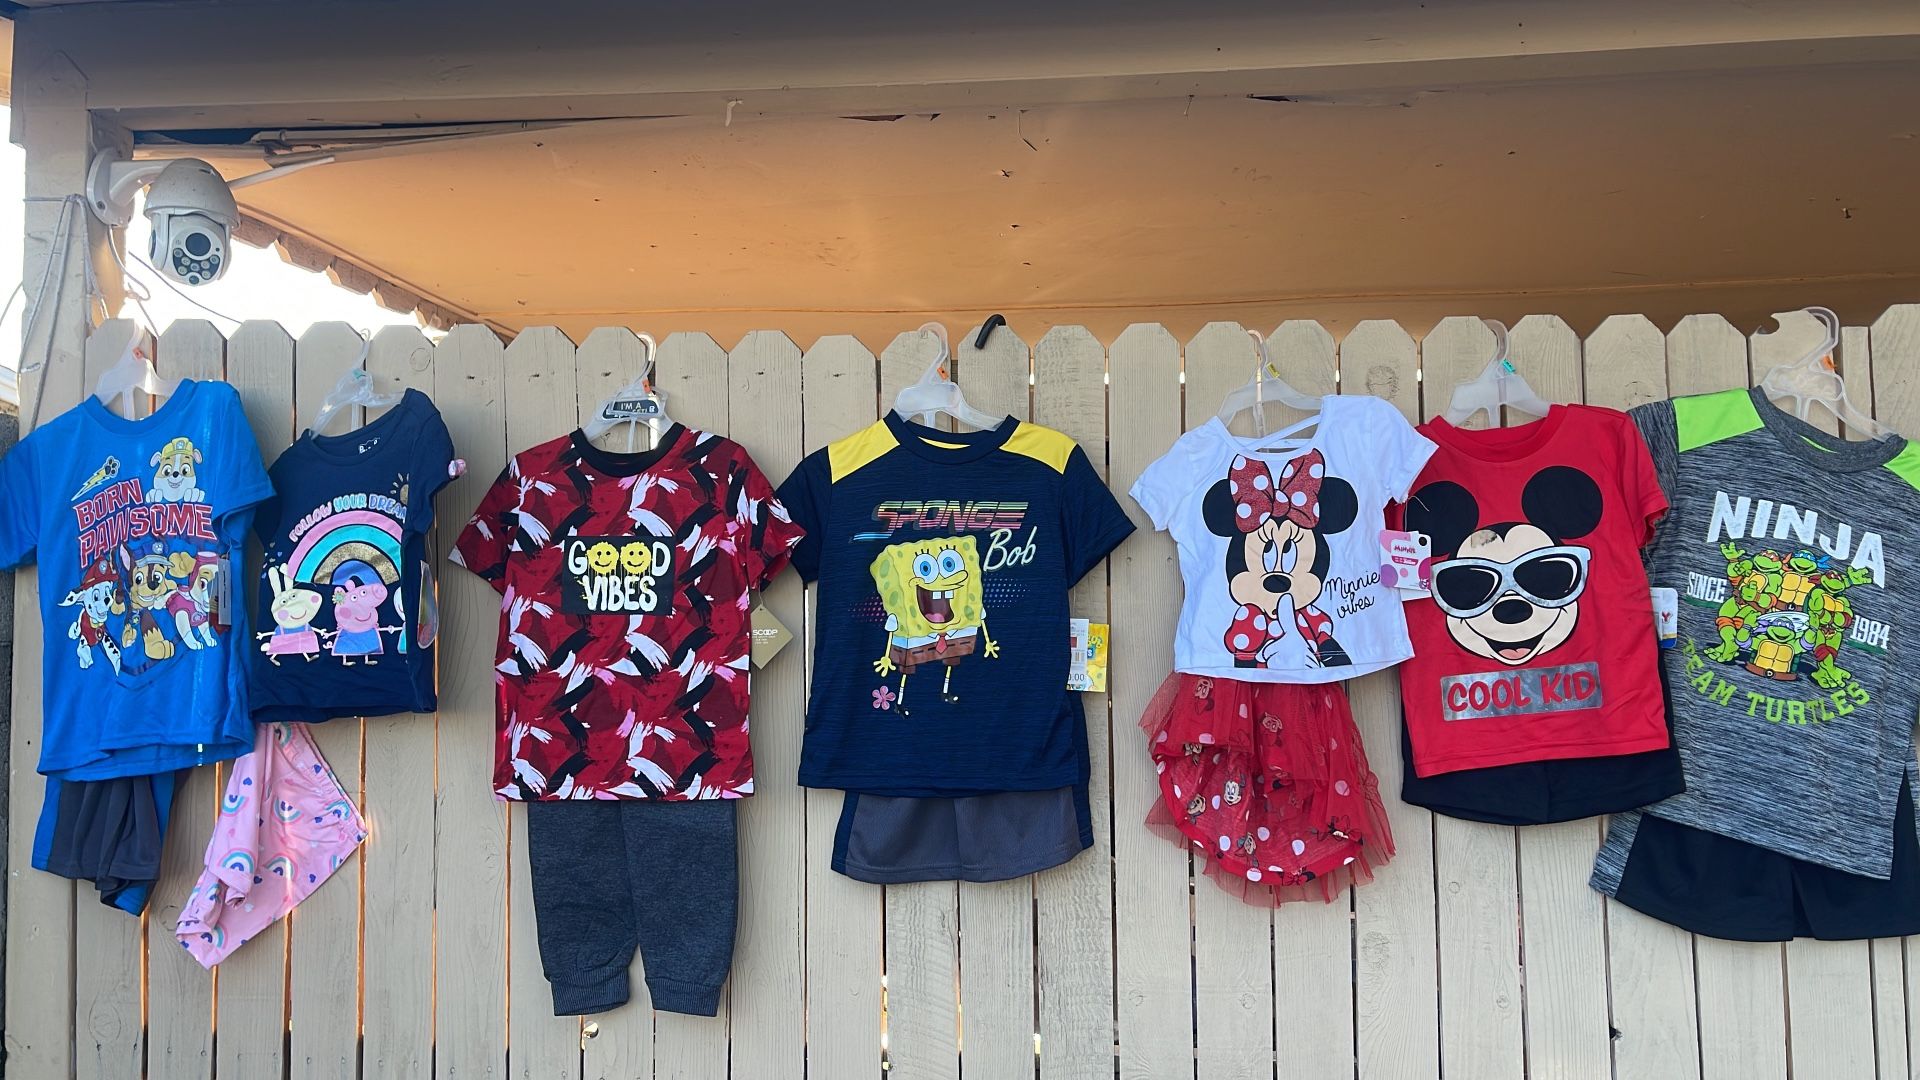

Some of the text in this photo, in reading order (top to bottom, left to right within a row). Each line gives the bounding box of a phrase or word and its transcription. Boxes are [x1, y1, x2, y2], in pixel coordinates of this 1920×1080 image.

[73, 478, 144, 531] BORN
[288, 501, 332, 542] FOLLOW
[333, 493, 367, 513] YOUR
[853, 500, 1029, 540] SPONGE
[78, 503, 217, 568] PAWSOME
[983, 525, 1037, 571] Bob
[1707, 491, 1887, 589] NINJA
[580, 575, 658, 612] VIBES
[1325, 570, 1380, 600] Minnie
[1337, 592, 1375, 618] vibes
[1687, 571, 1891, 650] SINCE 1984
[1447, 670, 1597, 712] COOL KID
[1683, 639, 1871, 726] TEAM TURTLES
